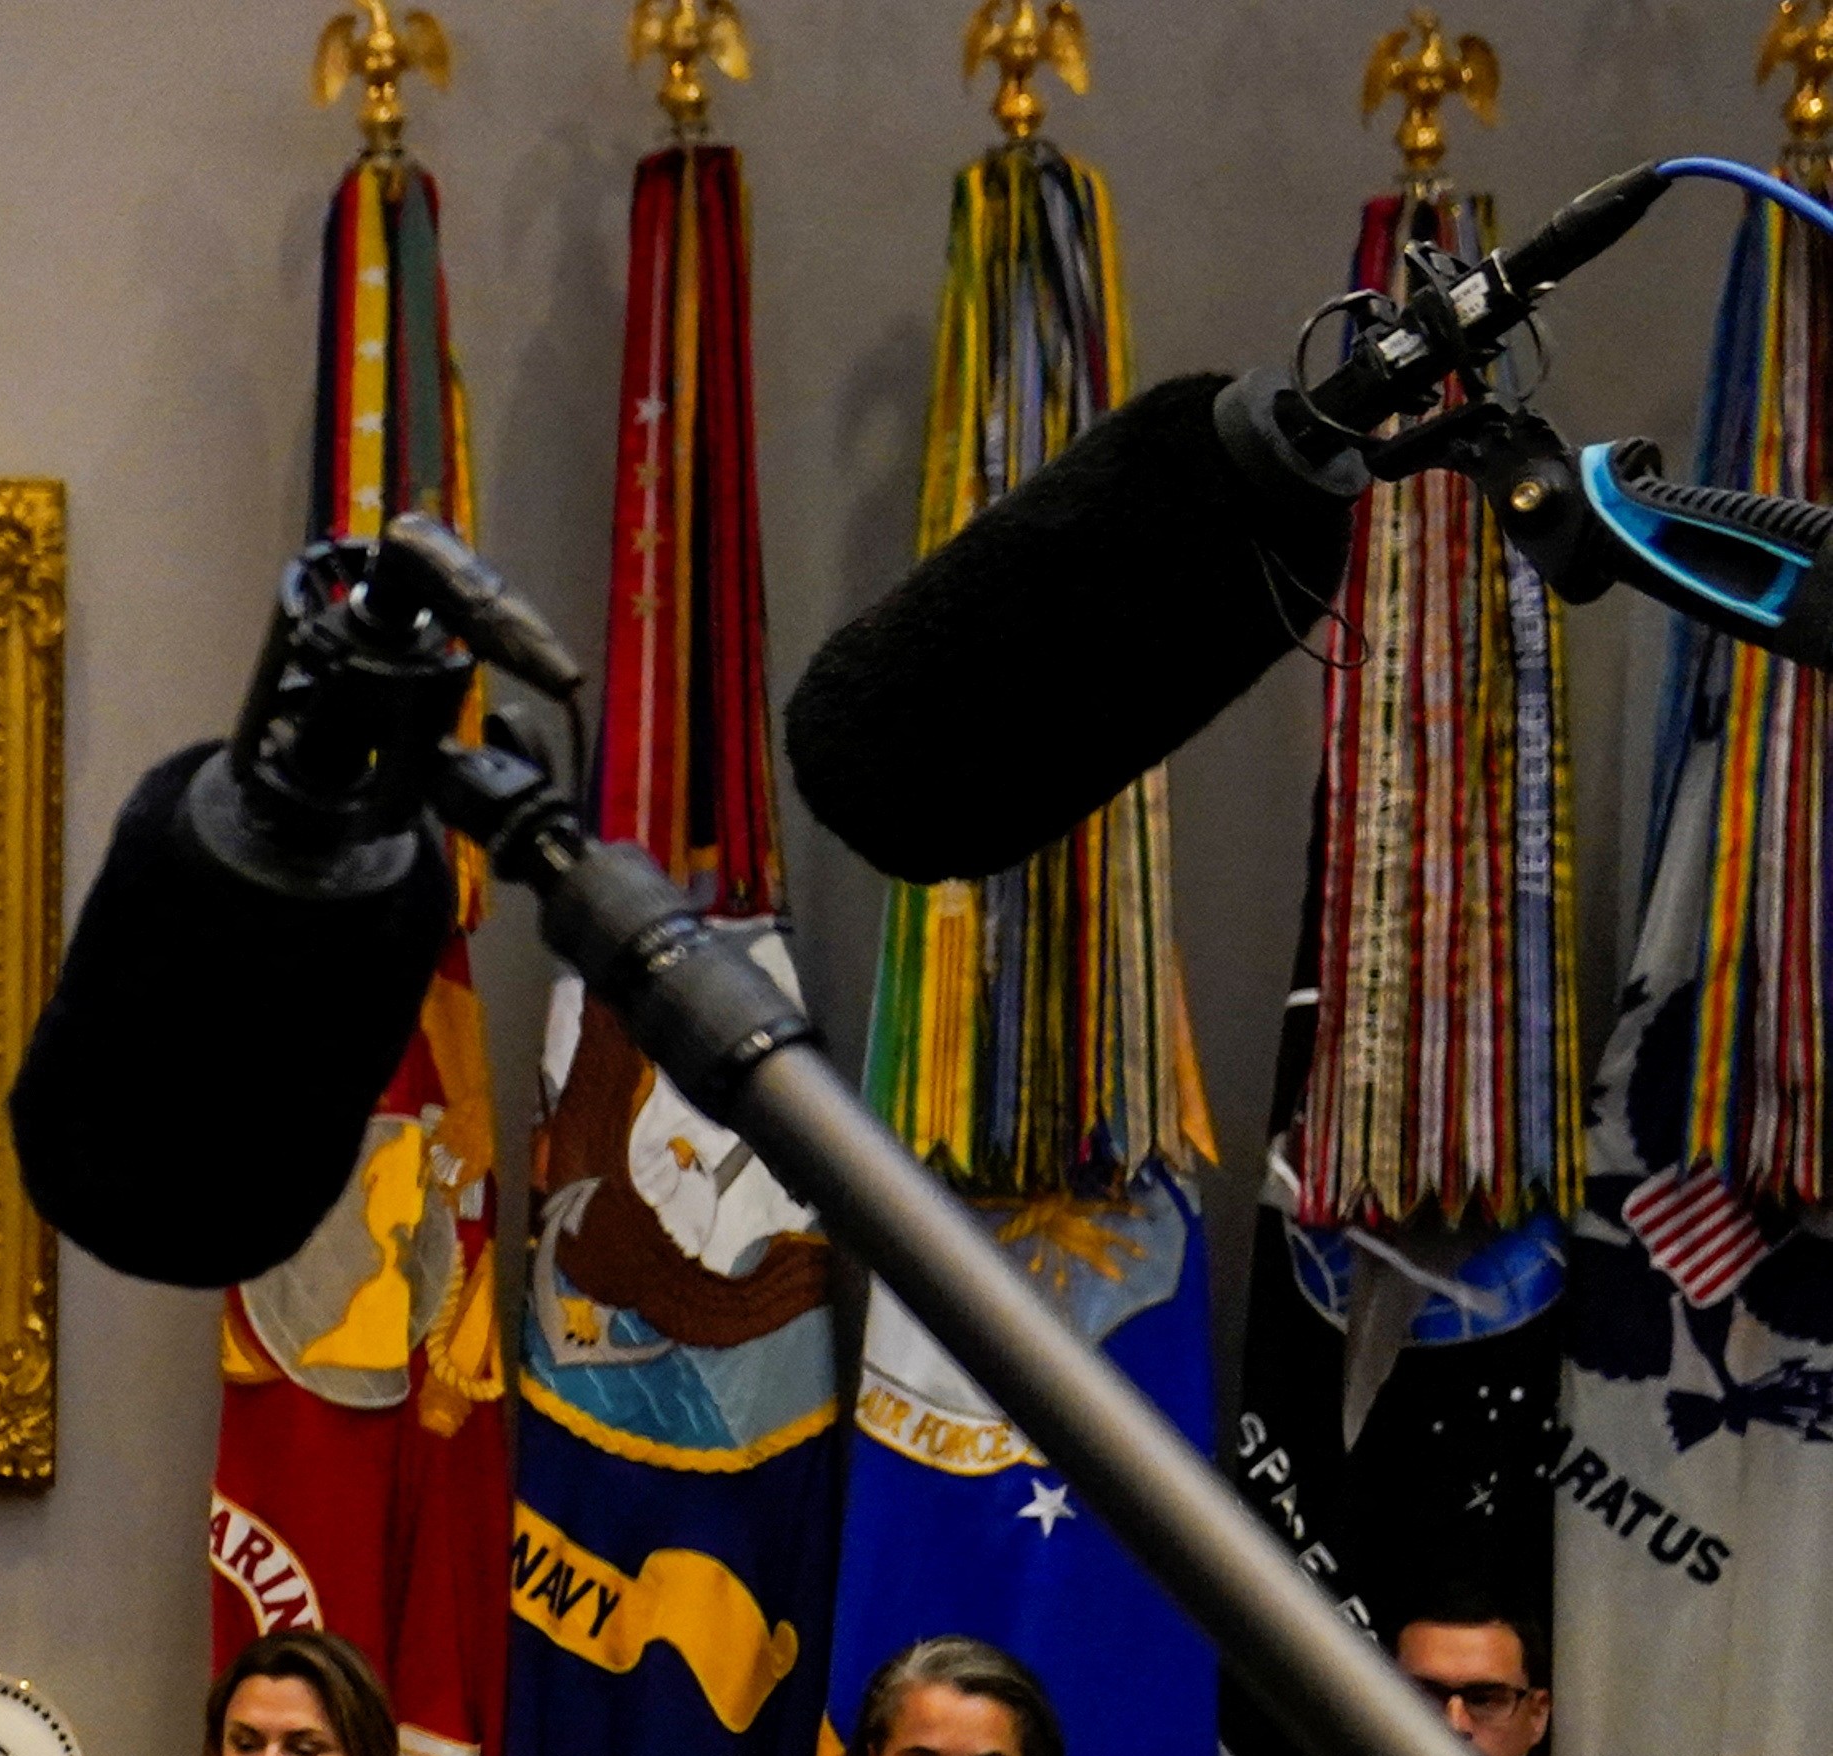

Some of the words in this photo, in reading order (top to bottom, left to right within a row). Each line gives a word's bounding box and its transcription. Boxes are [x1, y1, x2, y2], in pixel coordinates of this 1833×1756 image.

[909, 1411, 1013, 1464] FORCE
[1236, 1411, 1339, 1586] SPAE
[211, 1509, 313, 1636] ARIN
[511, 1531, 622, 1640] NAVY
